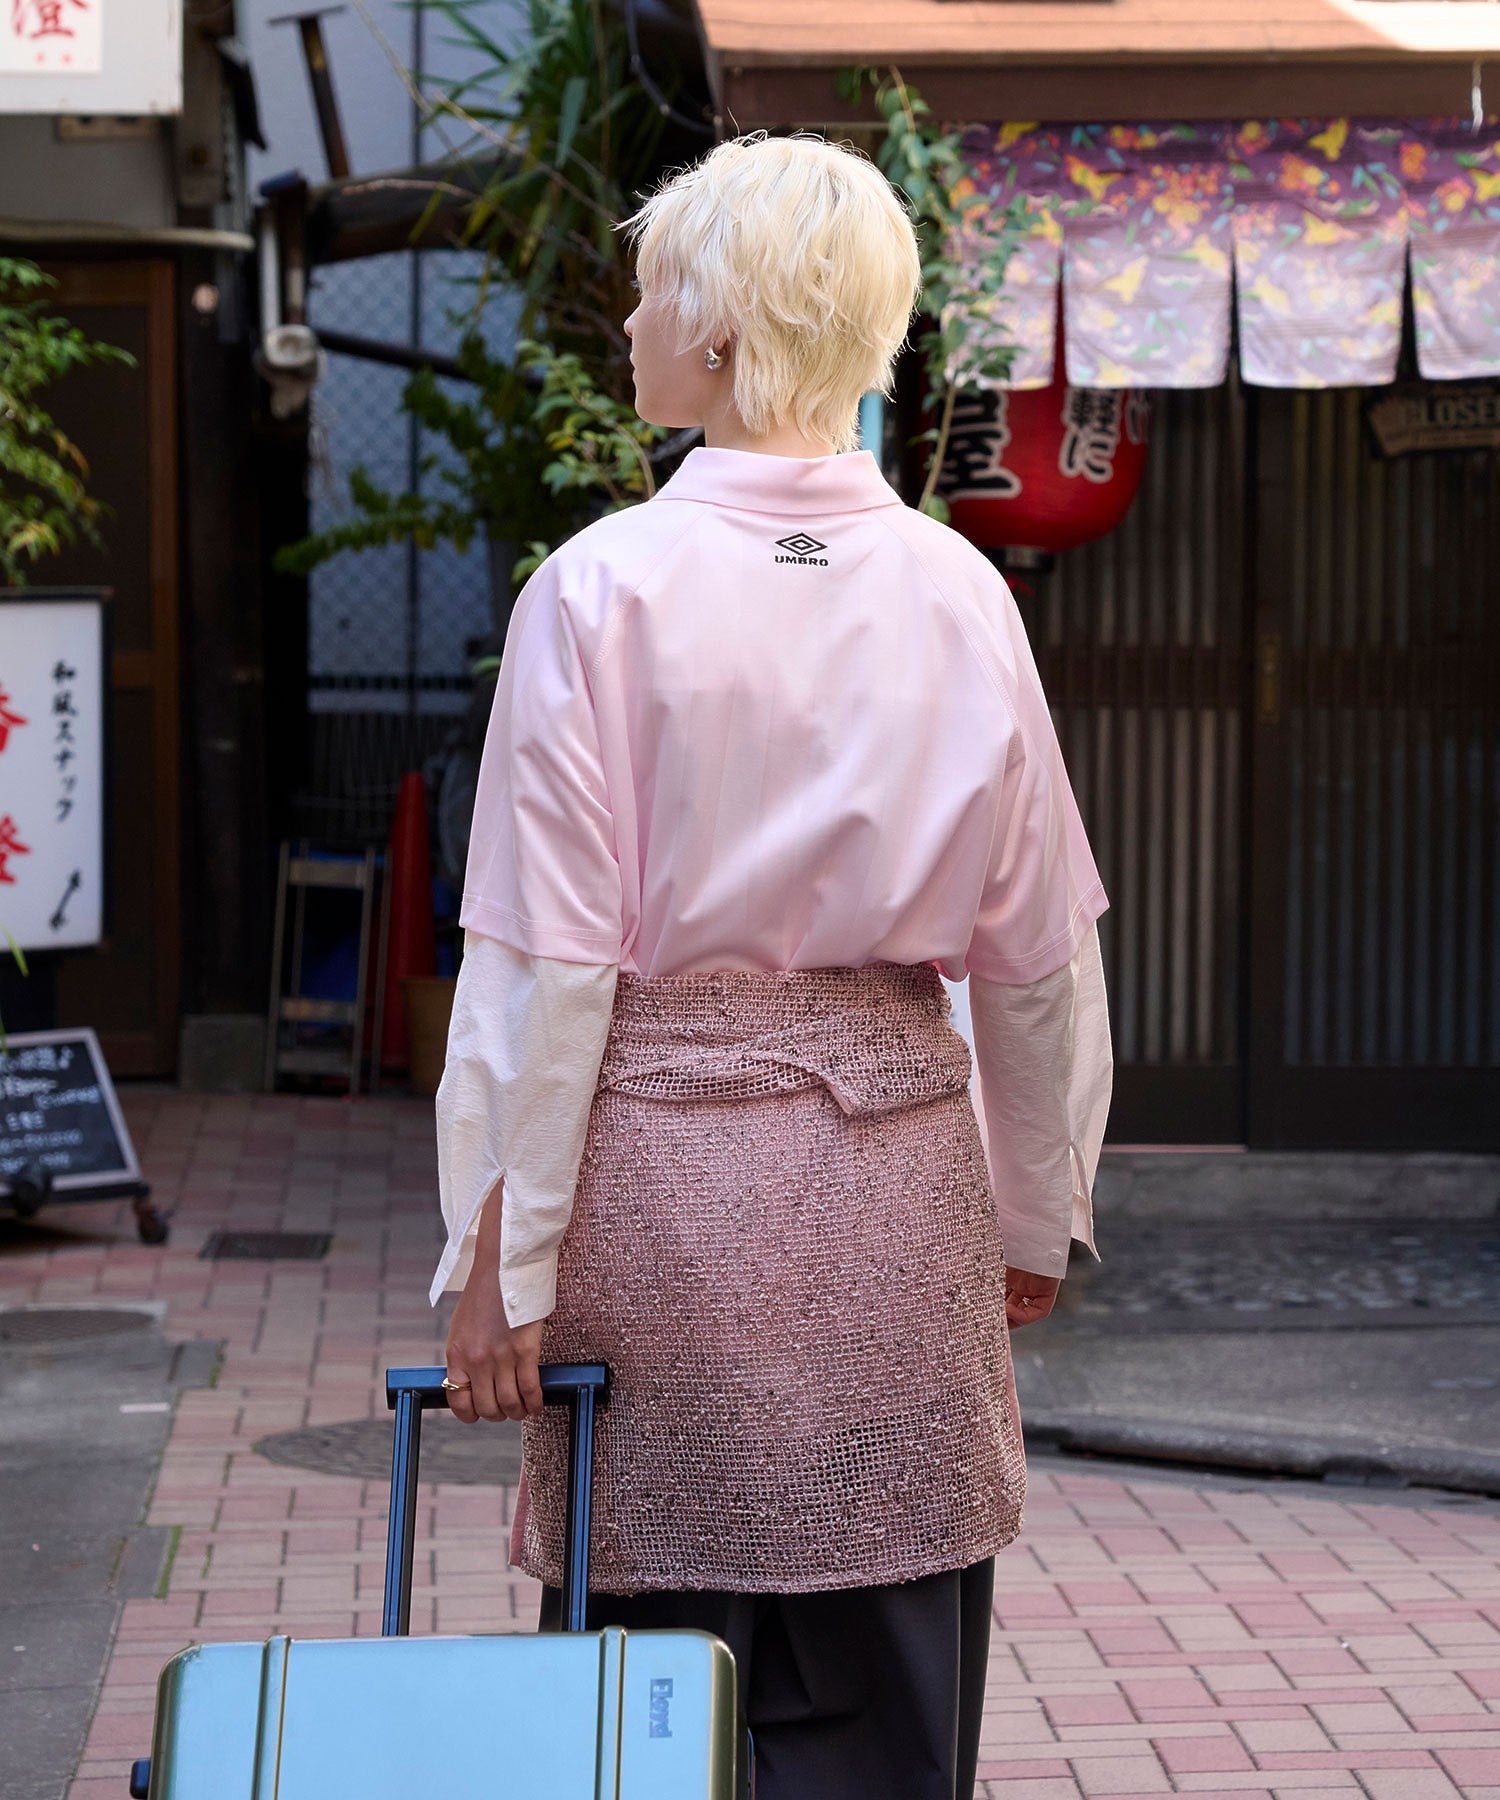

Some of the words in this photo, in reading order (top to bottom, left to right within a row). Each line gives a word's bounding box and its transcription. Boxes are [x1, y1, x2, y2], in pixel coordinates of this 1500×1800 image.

[775, 555, 829, 567] UMBRO
[53, 660, 78, 822] 和風スナック
